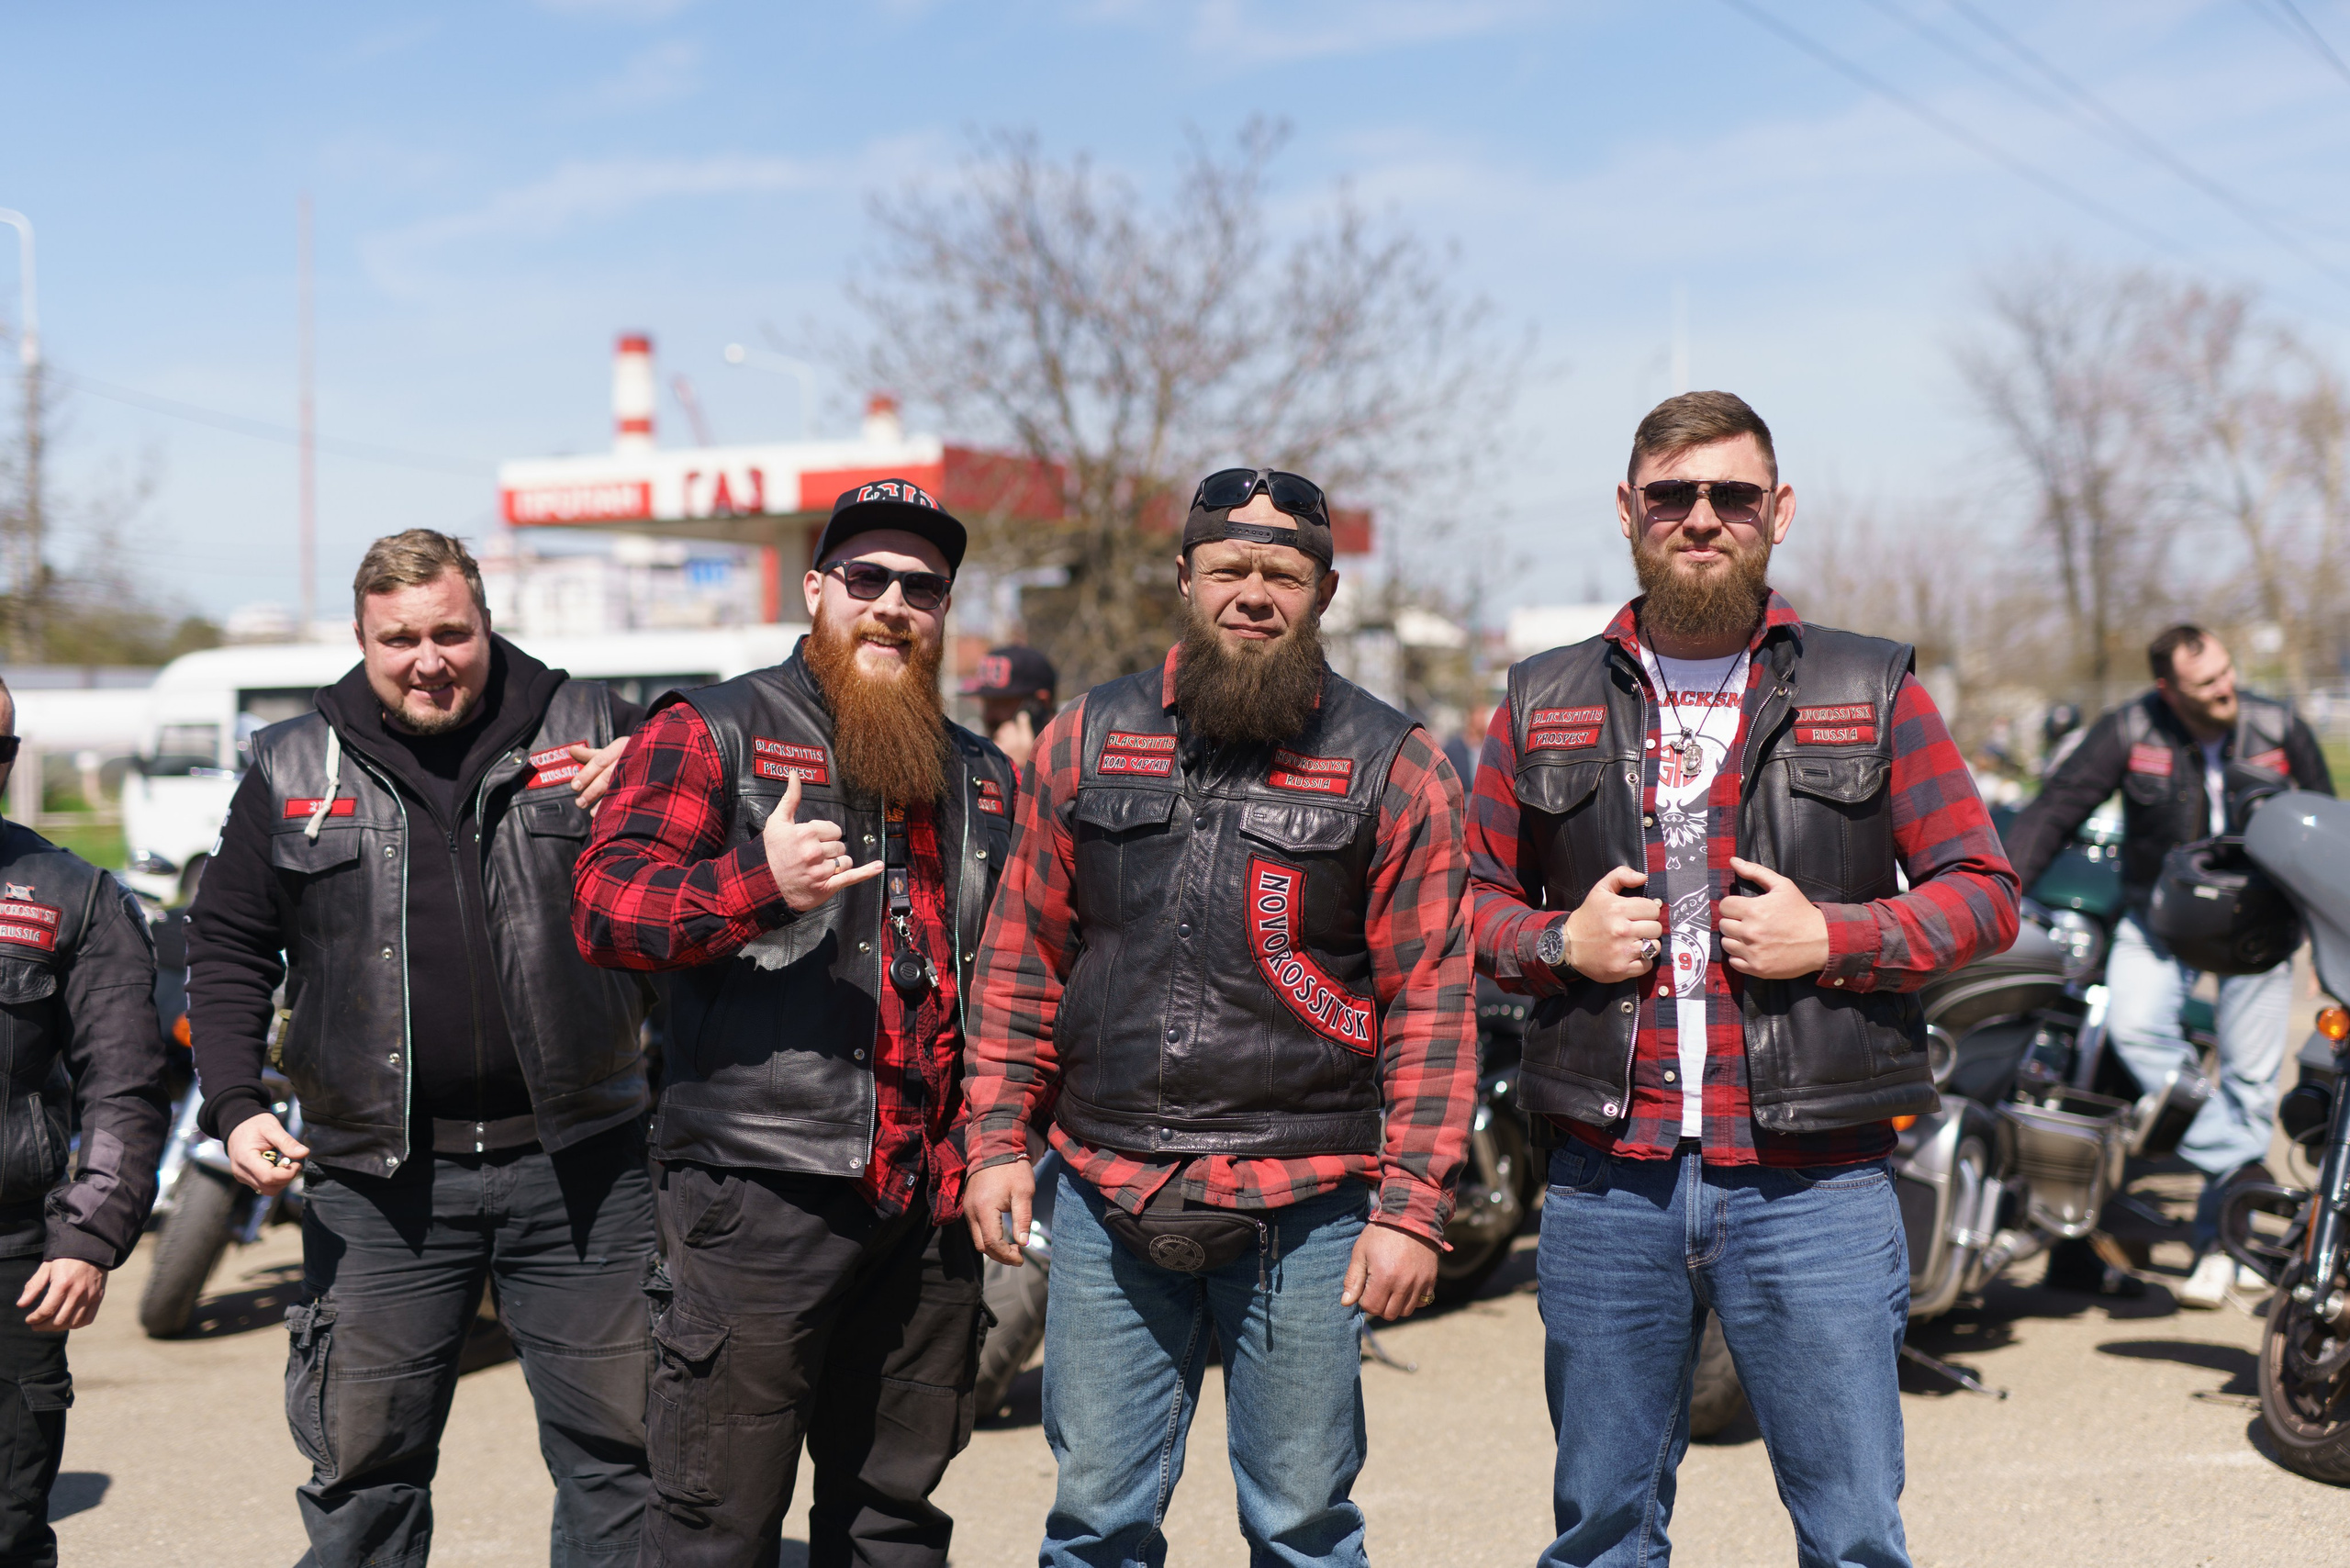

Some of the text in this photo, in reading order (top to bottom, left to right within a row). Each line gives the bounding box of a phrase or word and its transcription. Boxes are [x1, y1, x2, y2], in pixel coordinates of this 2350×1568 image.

[1658, 690, 1744, 709] ACKSM
[1533, 710, 1604, 724] BLACKSMITHS
[1107, 734, 1176, 749] BLACKSMITHS
[1535, 732, 1591, 745] PROSPECT
[1812, 728, 1858, 741] RUSSIA
[755, 739, 824, 761] BLACKSMITHS
[1102, 756, 1170, 772] ROAD CAPTAIN
[1275, 750, 1350, 772] NOVOROSSIYSK
[539, 765, 579, 784] RUSSIA
[1285, 774, 1331, 790] RUSSIA
[0, 925, 40, 942] RUSSIA
[1258, 870, 1370, 1042] NOVOROSSIYSK
[1671, 952, 1692, 970] 9
